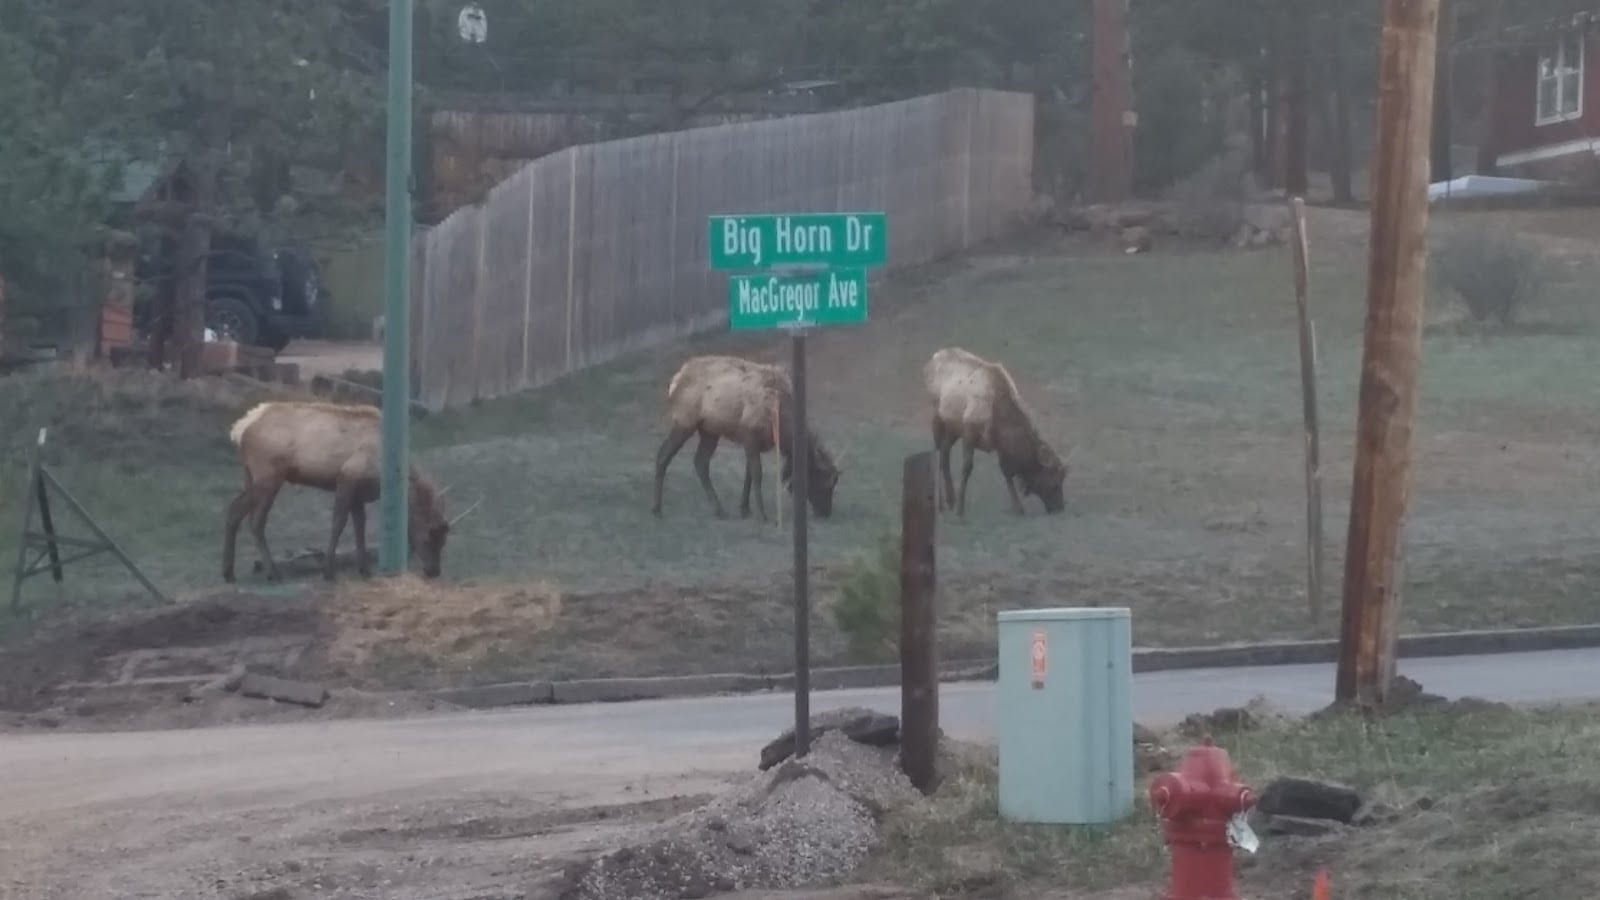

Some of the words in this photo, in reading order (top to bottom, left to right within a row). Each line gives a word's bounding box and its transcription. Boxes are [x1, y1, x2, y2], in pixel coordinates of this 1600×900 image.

[723, 218, 761, 265] Big
[776, 217, 832, 254] Horn
[846, 216, 873, 251] Dr
[739, 277, 820, 321] MacGregor
[828, 272, 857, 308] Ave
